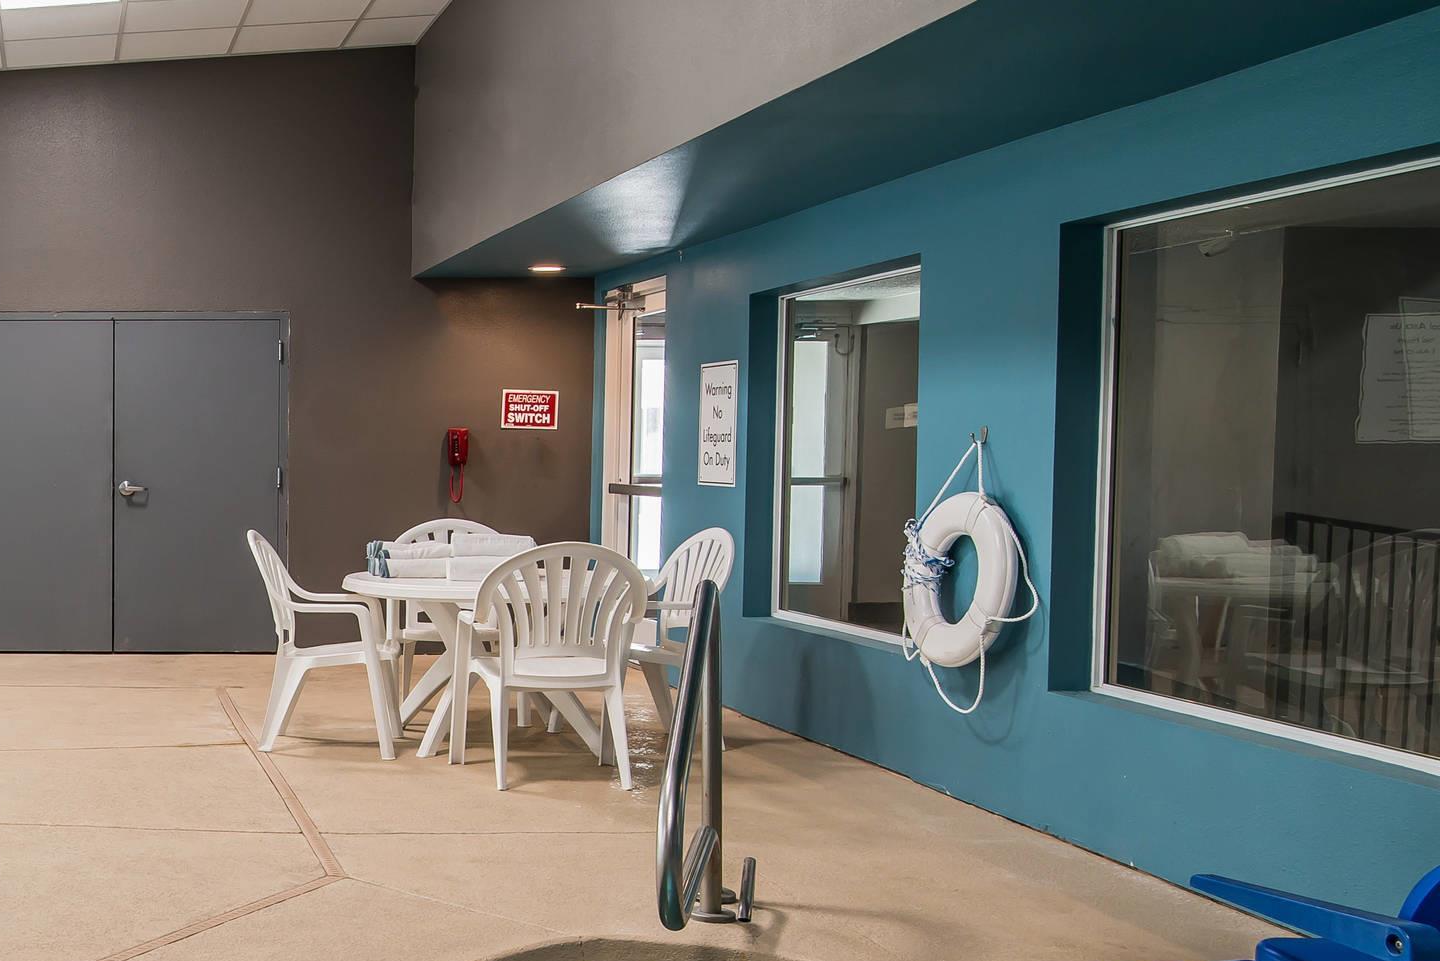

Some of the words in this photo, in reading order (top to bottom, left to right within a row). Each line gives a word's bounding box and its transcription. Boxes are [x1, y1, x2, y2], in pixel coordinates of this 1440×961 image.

[705, 382, 732, 399] Warning
[508, 394, 551, 403] EMERGENCY
[509, 403, 550, 412] SHUT-OFF
[712, 406, 723, 419] No
[507, 412, 551, 424] SWITCH
[703, 427, 732, 447] Lifeguard
[703, 451, 713, 466] On
[715, 452, 731, 471] Duty
